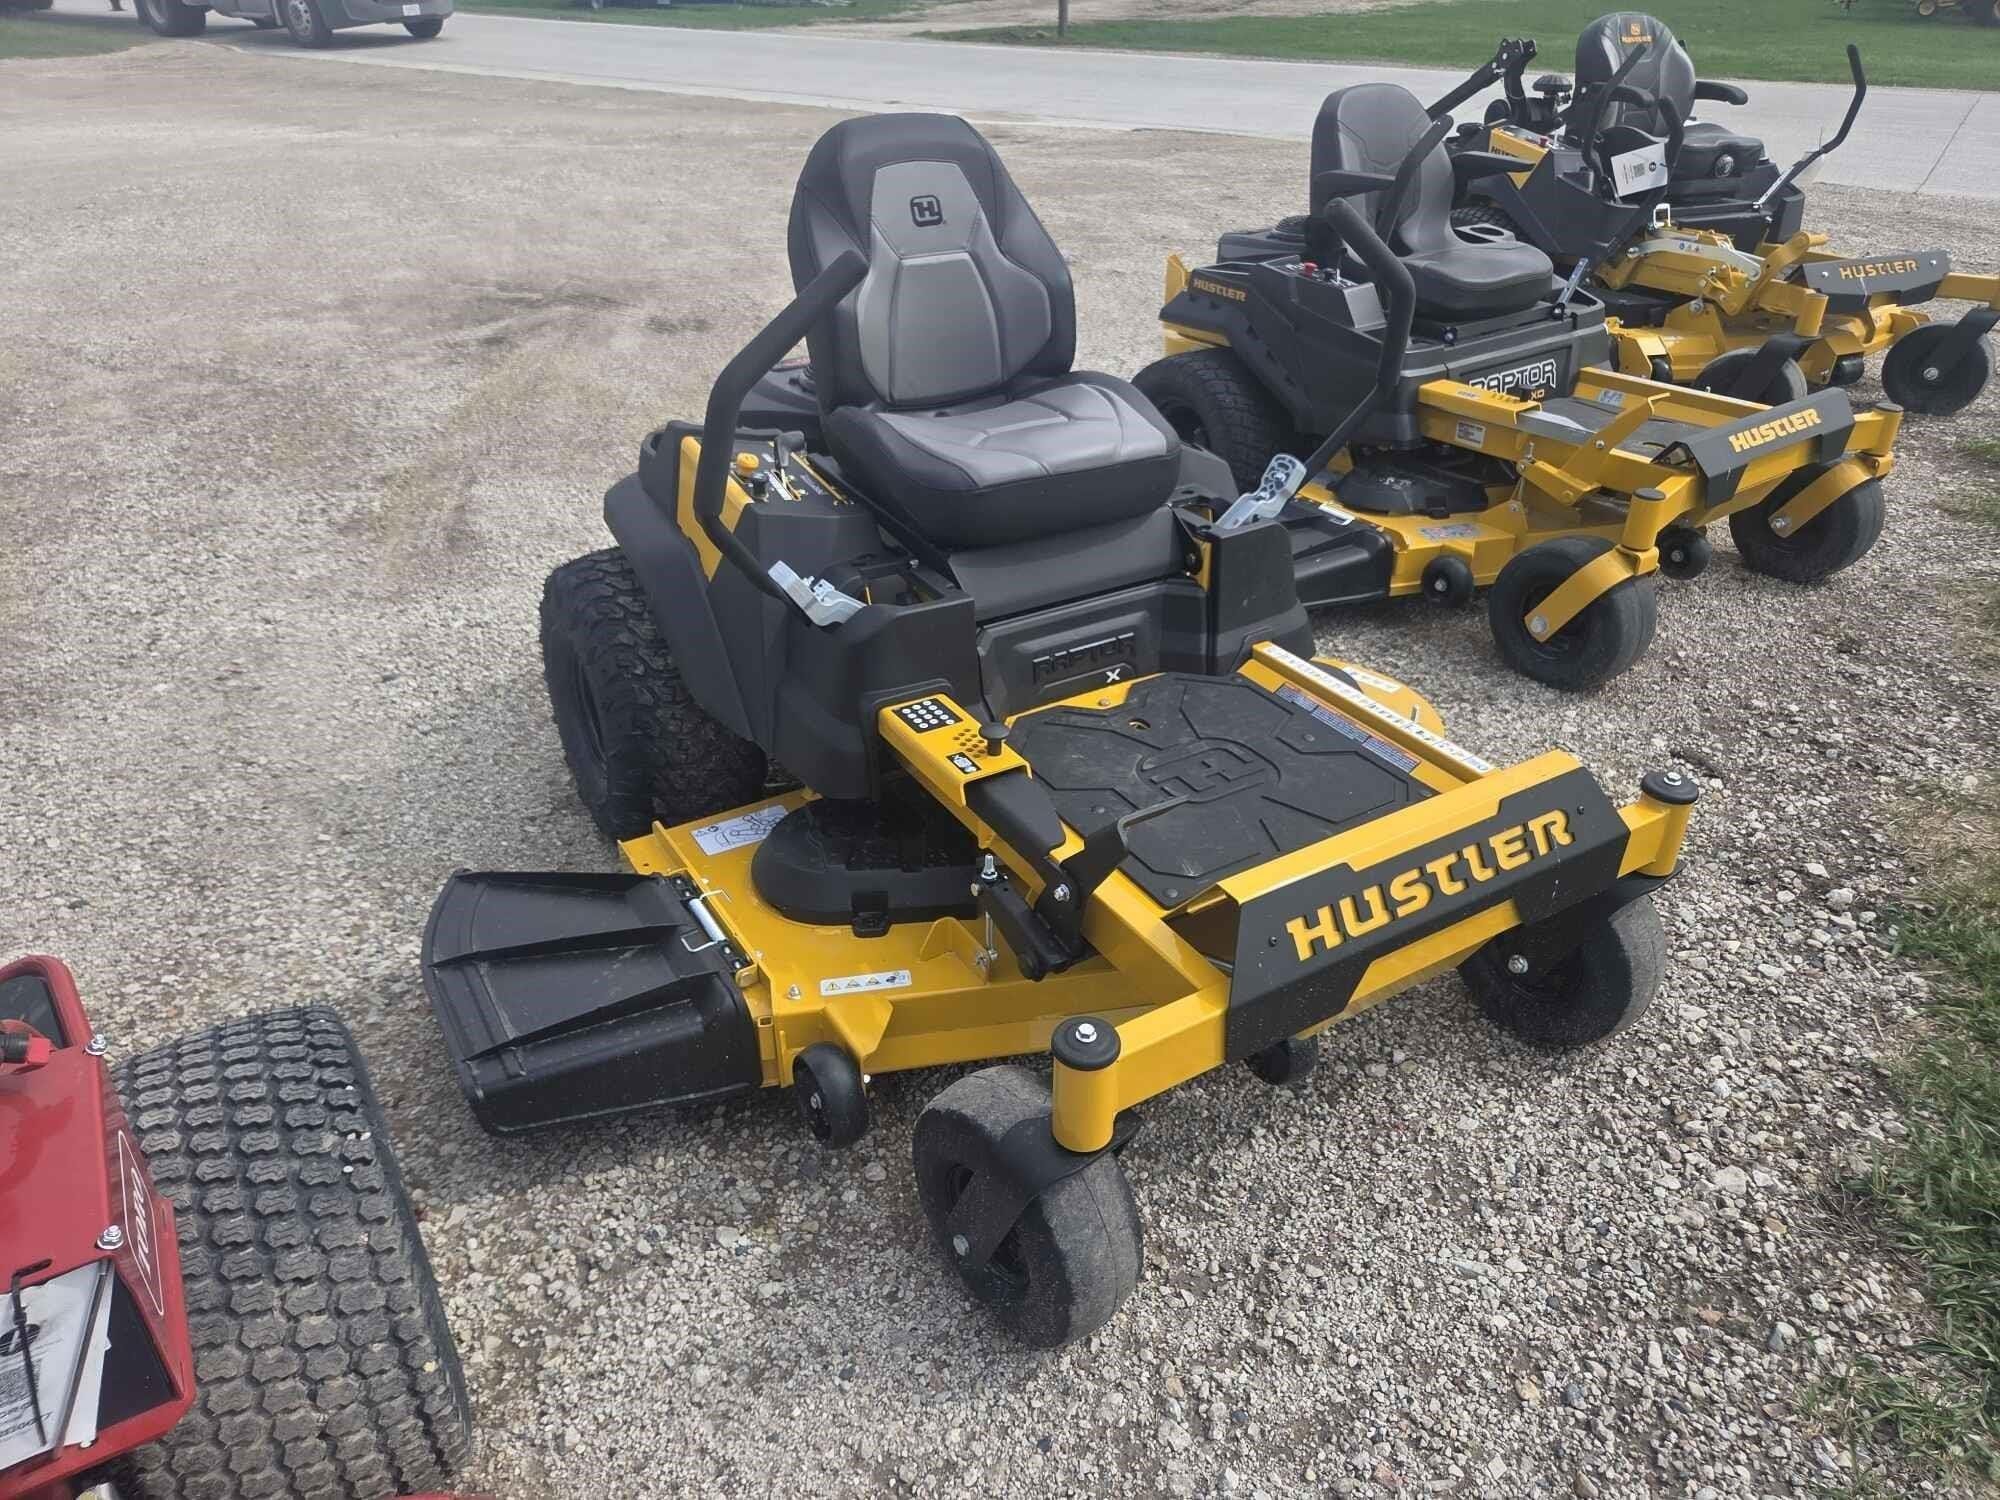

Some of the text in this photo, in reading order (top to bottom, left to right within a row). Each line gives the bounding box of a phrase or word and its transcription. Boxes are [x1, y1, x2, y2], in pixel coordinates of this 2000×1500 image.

[1839, 259, 1918, 280] HUSTLER
[1191, 278, 1247, 302] HUSTLER
[1728, 408, 1822, 453] HUSTLER
[1105, 668, 1121, 684] X
[1285, 809, 1574, 961] HUSTLER
